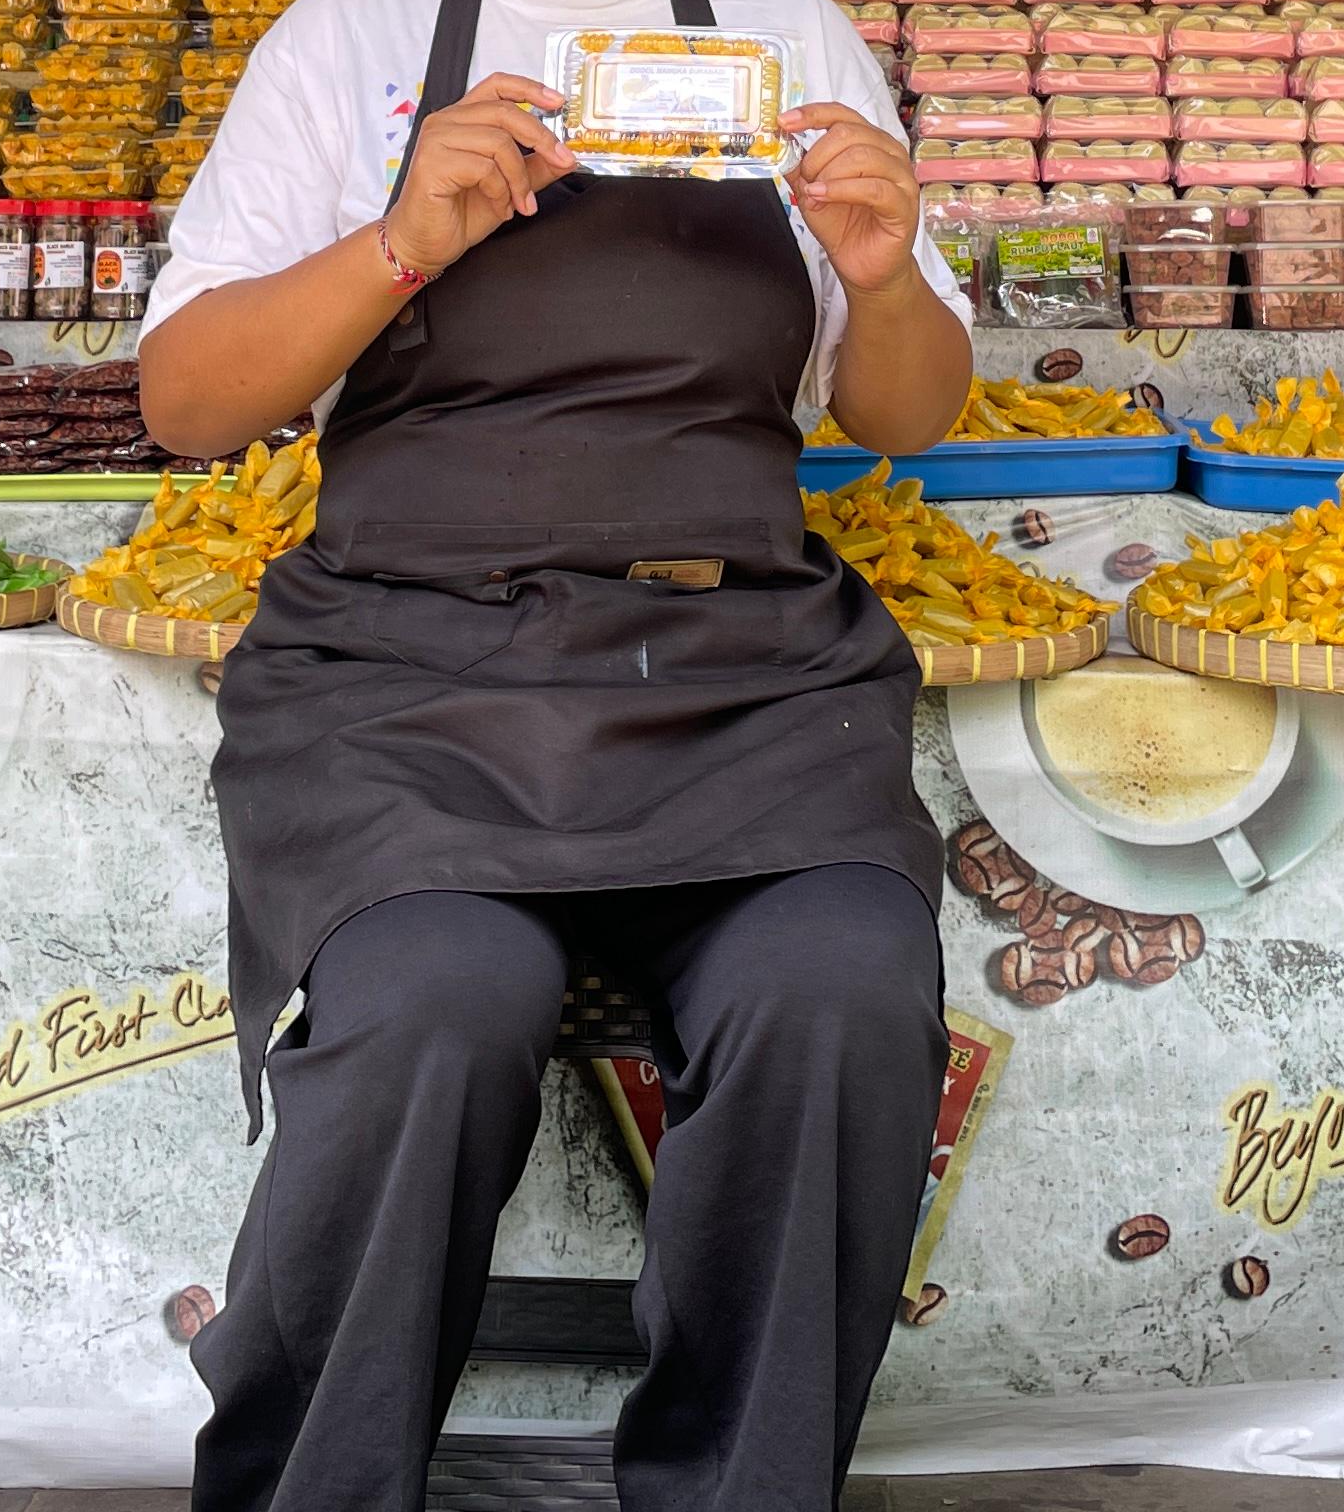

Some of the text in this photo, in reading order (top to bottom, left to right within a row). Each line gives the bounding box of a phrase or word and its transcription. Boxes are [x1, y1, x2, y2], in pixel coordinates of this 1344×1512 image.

[1010, 243, 1057, 256] RUMPUT
[42, 994, 159, 1073] First
[172, 977, 235, 1029] Cla
